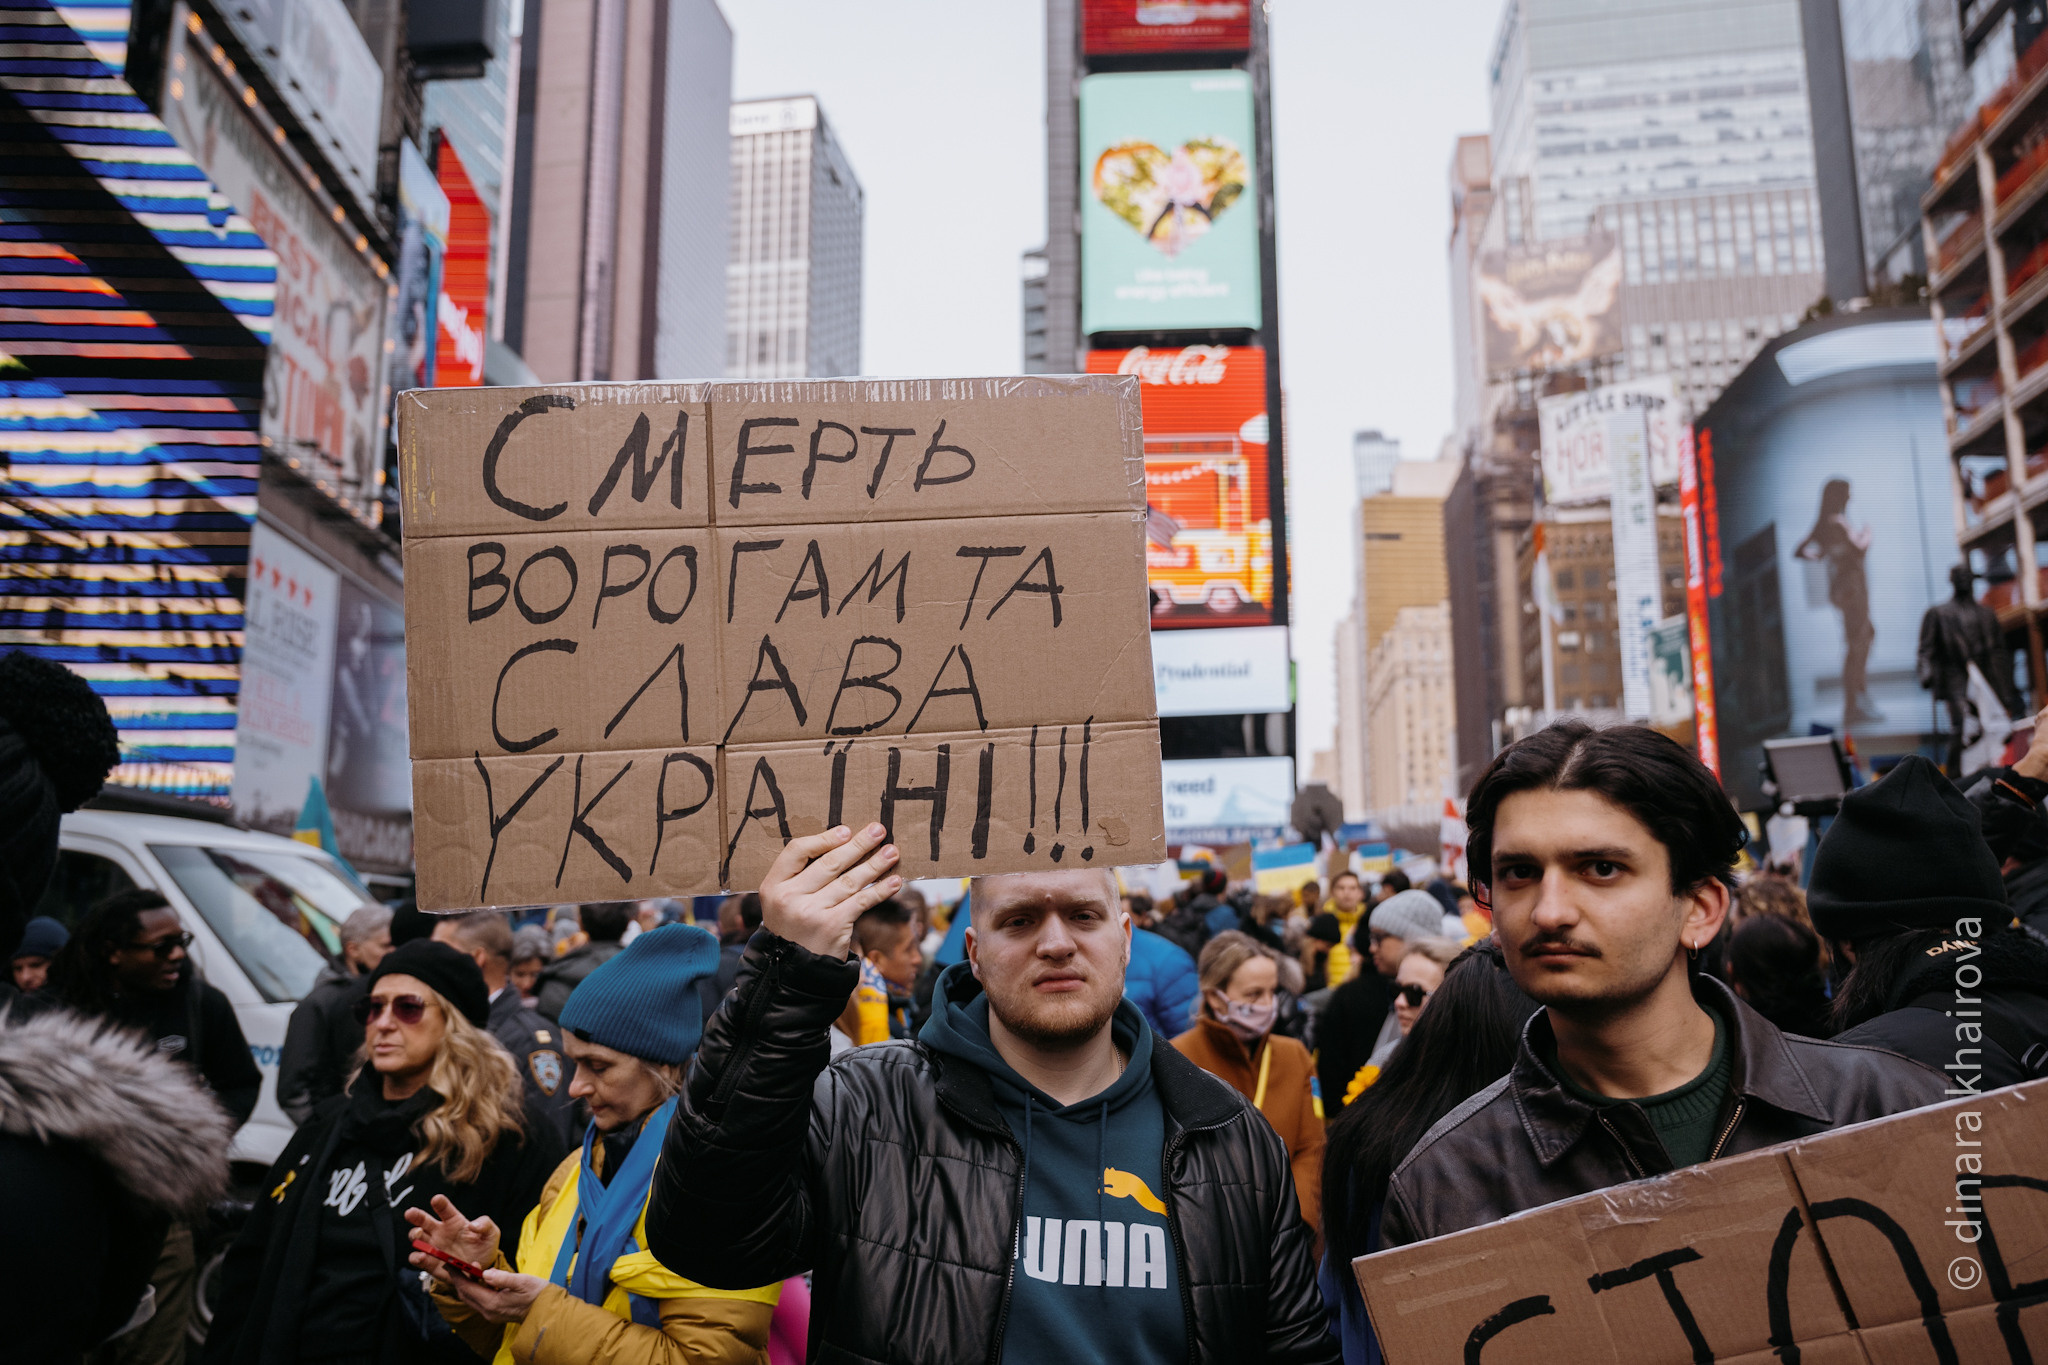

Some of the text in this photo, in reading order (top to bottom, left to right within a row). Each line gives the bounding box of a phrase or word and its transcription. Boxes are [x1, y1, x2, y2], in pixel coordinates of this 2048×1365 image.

[483, 394, 976, 521] СМЕРТЬ
[467, 538, 1064, 631] ВОРОГАМ ТА
[491, 634, 989, 753] СЛАВА
[1015, 1215, 1168, 1290] UMA
